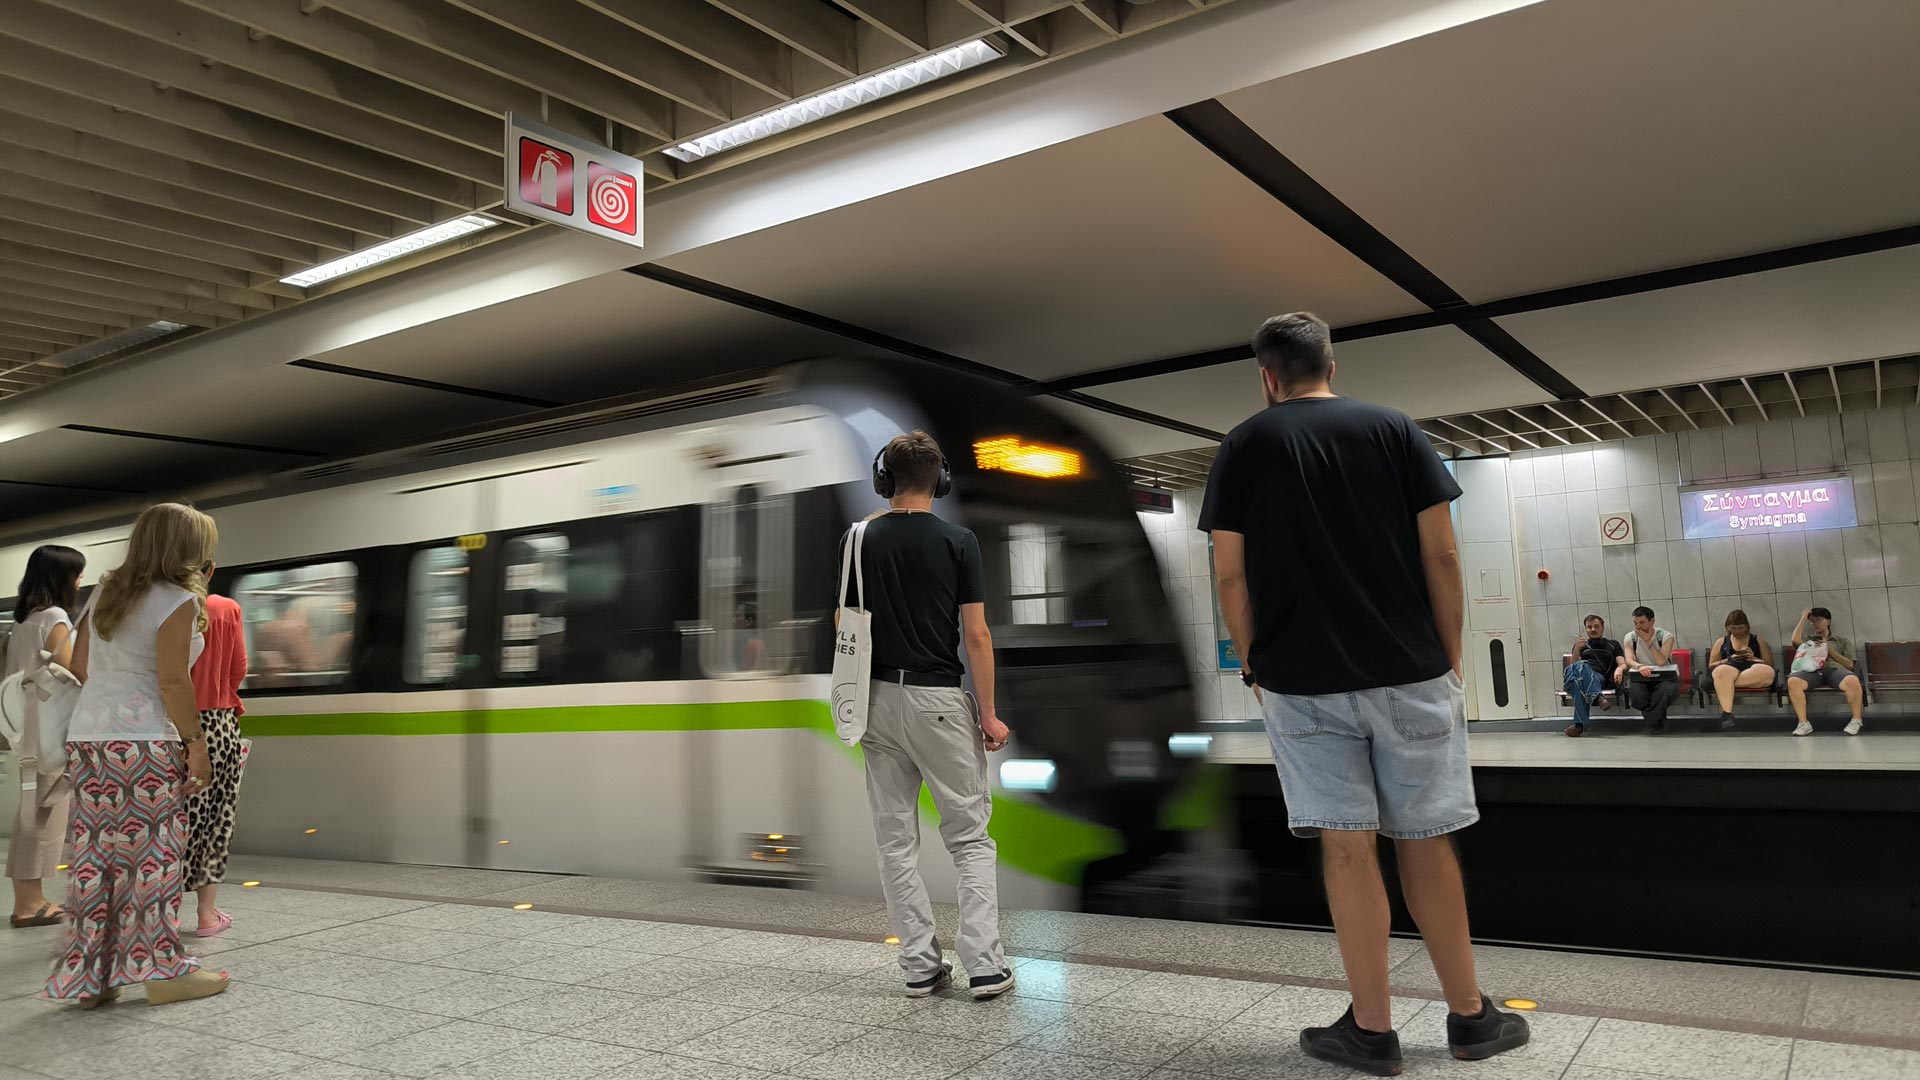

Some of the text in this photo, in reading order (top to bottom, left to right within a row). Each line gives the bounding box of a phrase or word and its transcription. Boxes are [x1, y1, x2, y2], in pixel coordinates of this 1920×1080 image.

[1702, 488, 1830, 512] Σύνταγμα
[1729, 512, 1807, 530] Syntagma
[850, 633, 856, 643] &
